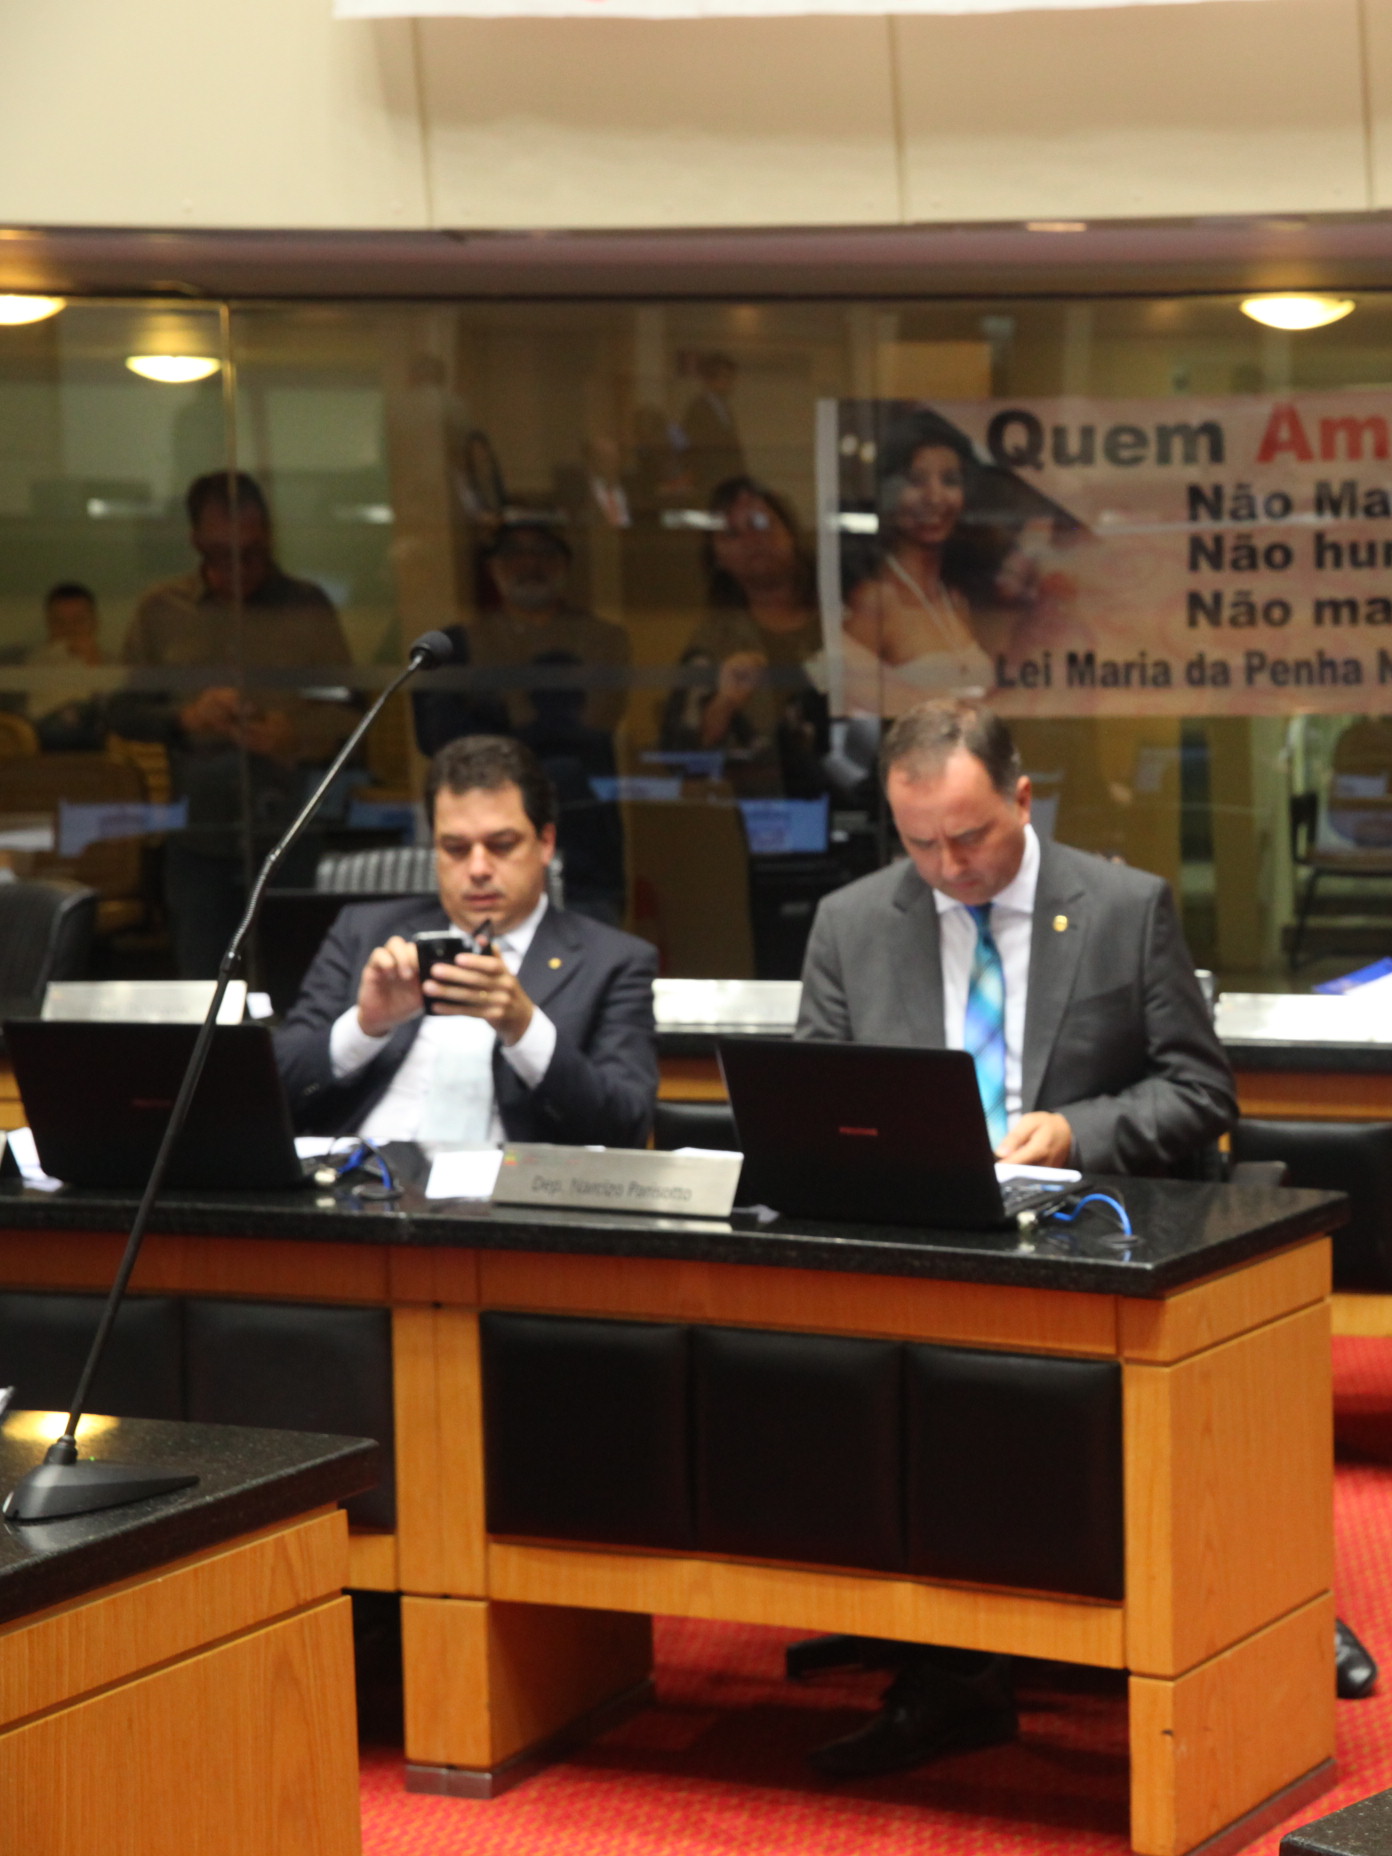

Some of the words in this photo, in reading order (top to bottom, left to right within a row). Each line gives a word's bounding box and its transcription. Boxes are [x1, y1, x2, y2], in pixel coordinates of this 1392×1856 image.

[987, 409, 1226, 470] Quem
[1187, 483, 1294, 521] Não
[1187, 532, 1293, 572] Não
[1186, 590, 1292, 628] Não
[996, 651, 1052, 688] Lei
[1067, 651, 1172, 688] Maria
[1185, 651, 1231, 687] da
[1244, 650, 1363, 686] Penha
